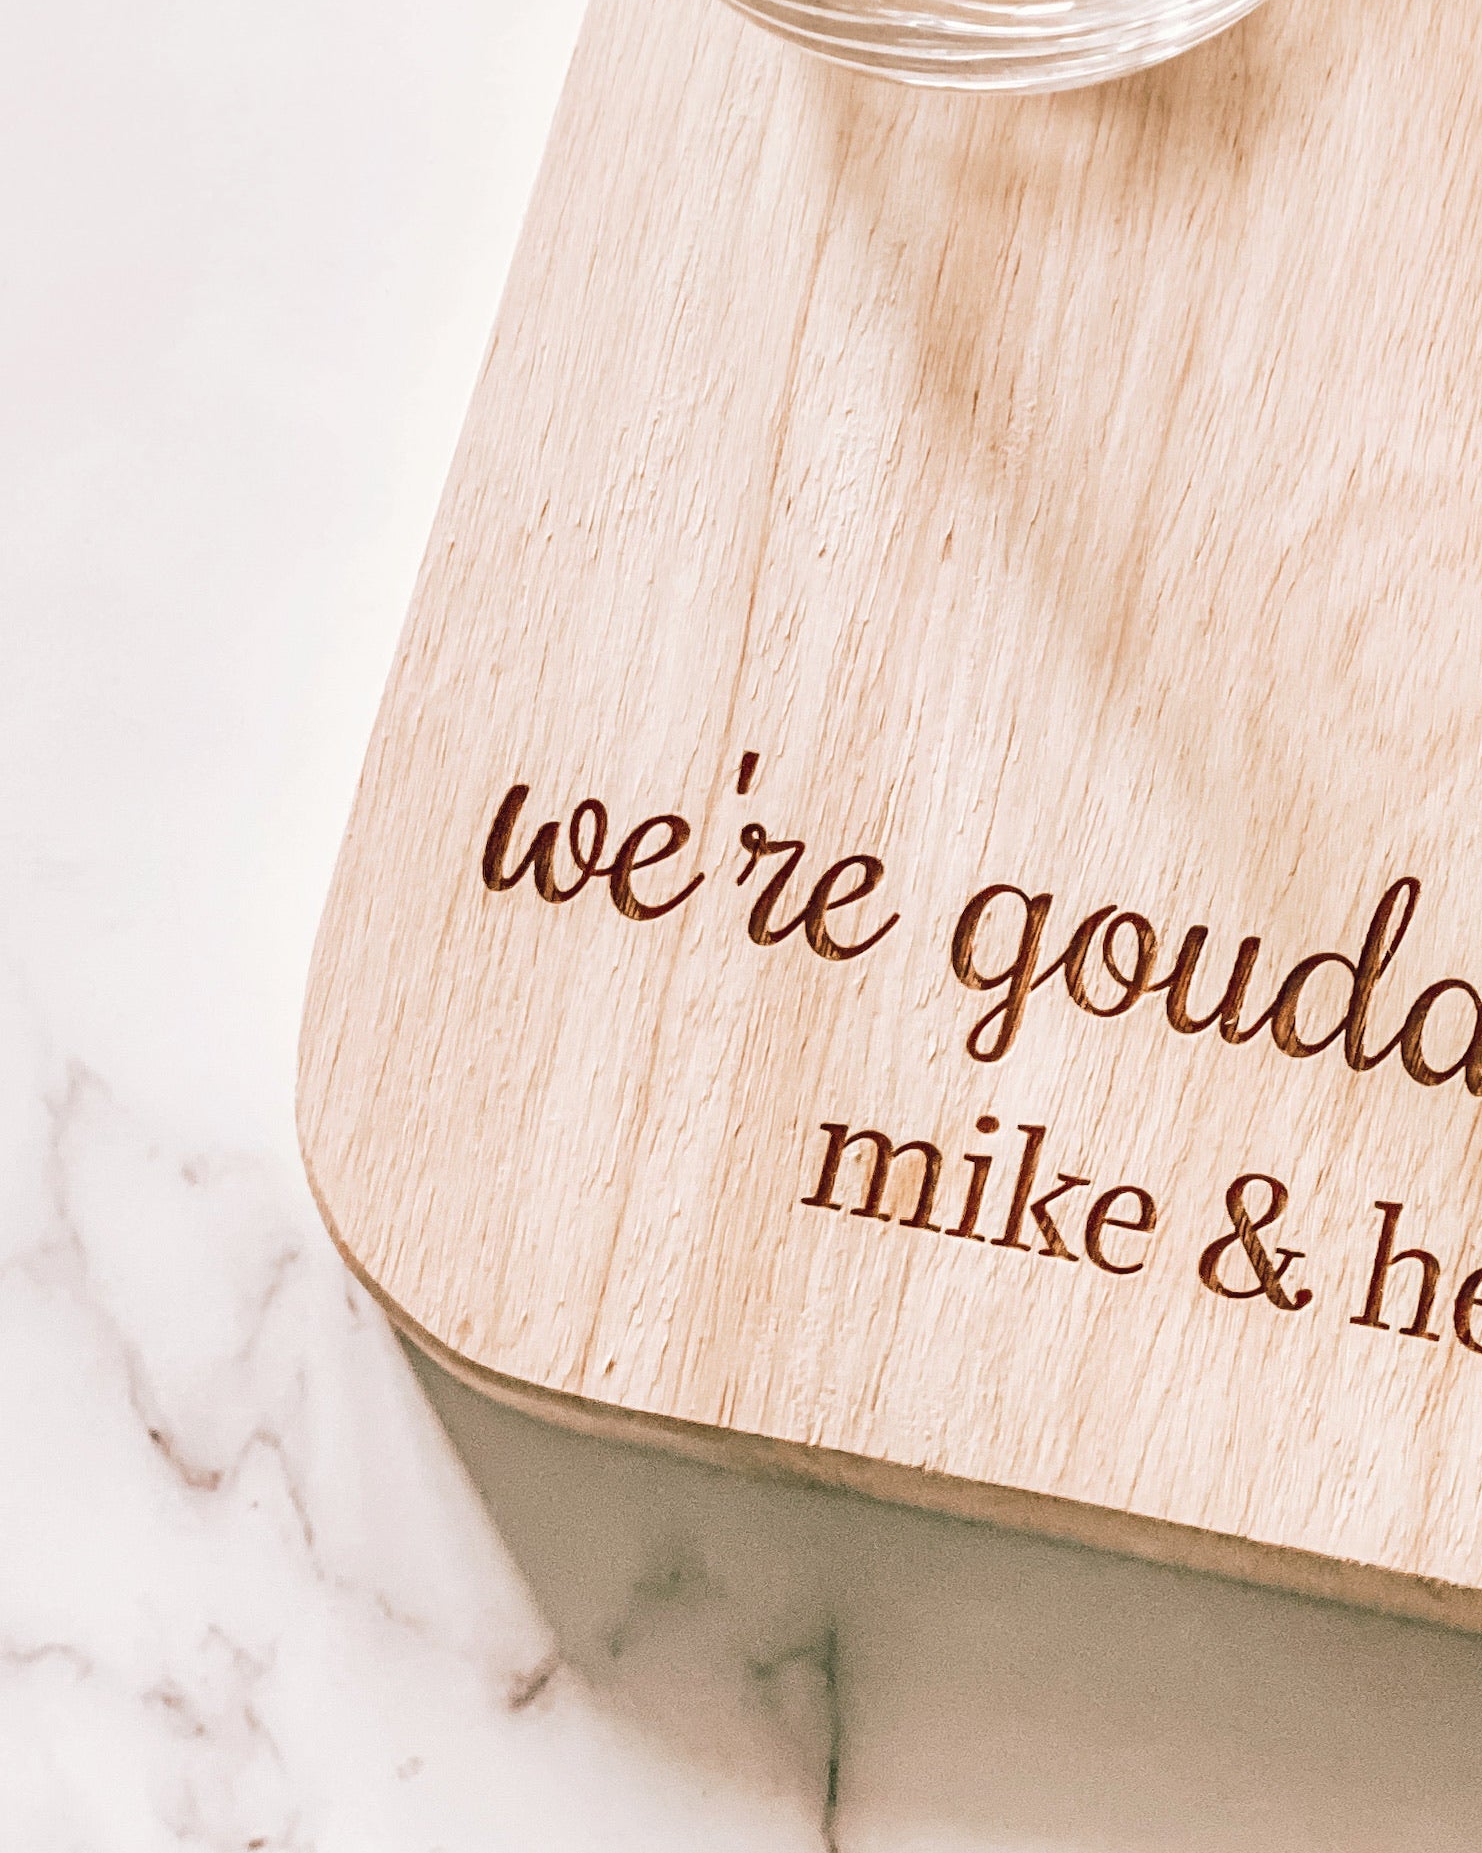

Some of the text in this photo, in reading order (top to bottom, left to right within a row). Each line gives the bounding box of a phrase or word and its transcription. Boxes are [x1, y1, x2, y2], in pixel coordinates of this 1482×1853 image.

[482, 752, 900, 961] we're
[801, 1115, 1159, 1276] mike
[1199, 1172, 1313, 1311] &
